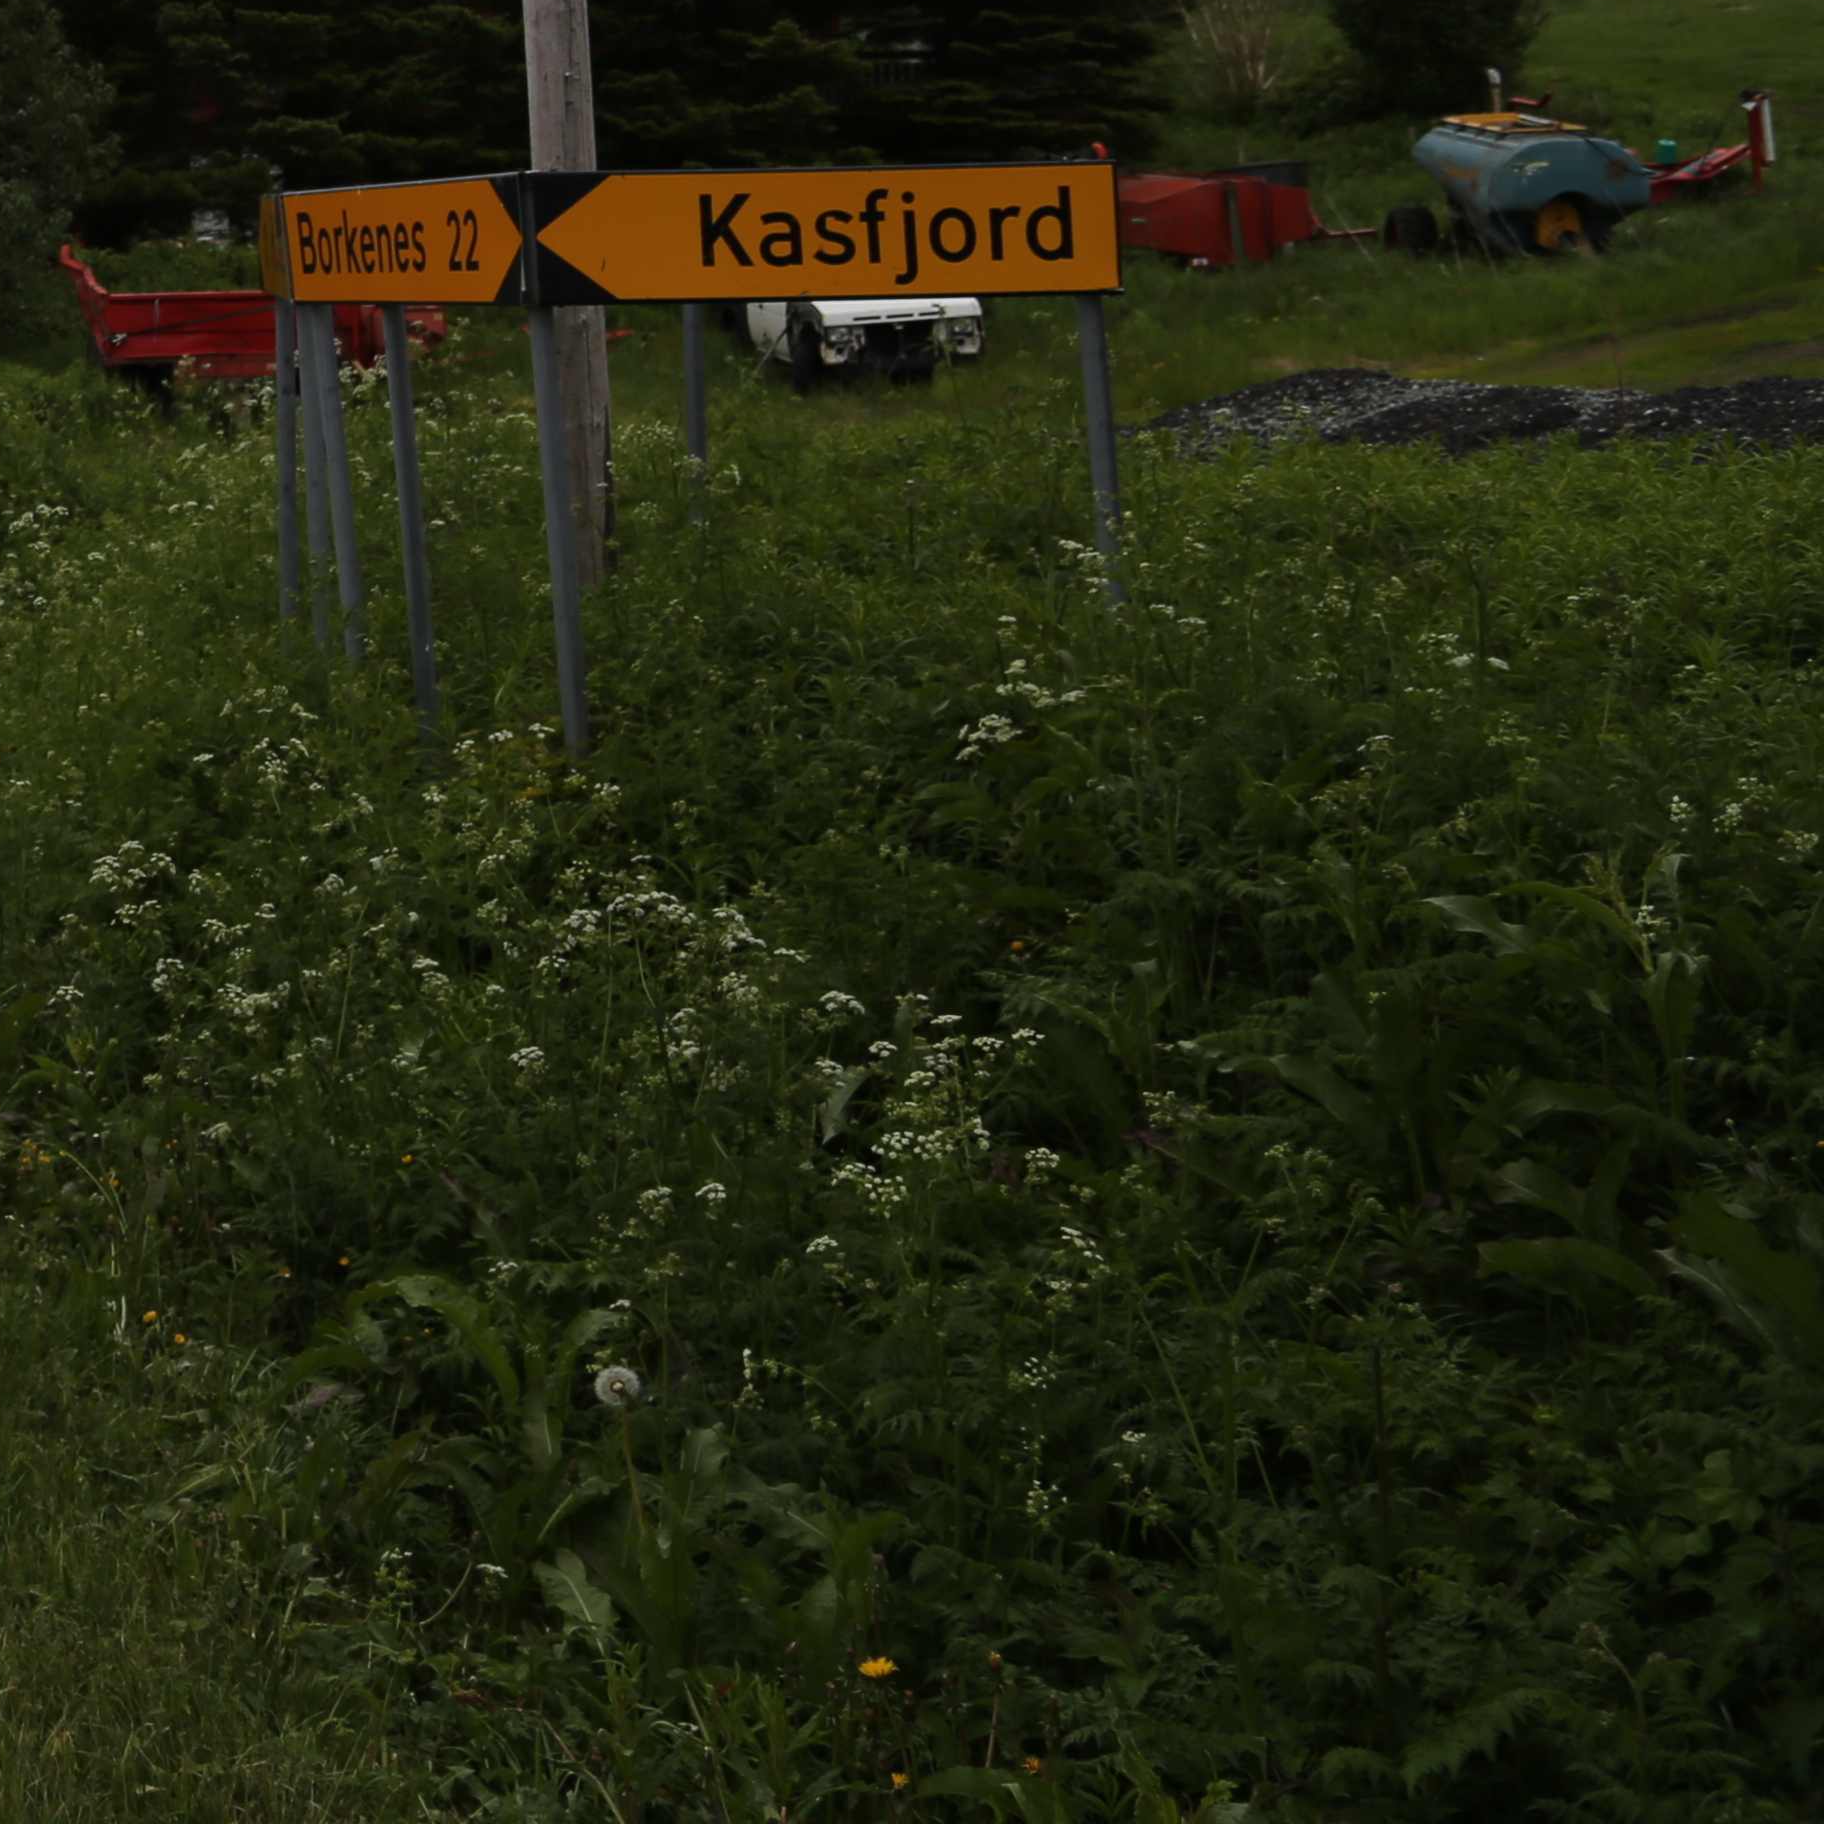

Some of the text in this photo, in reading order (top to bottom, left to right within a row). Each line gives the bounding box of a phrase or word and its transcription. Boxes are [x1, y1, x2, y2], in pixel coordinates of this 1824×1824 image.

[296, 209, 480, 275] Borkenes 22
[698, 185, 1075, 285] Kasfjord
